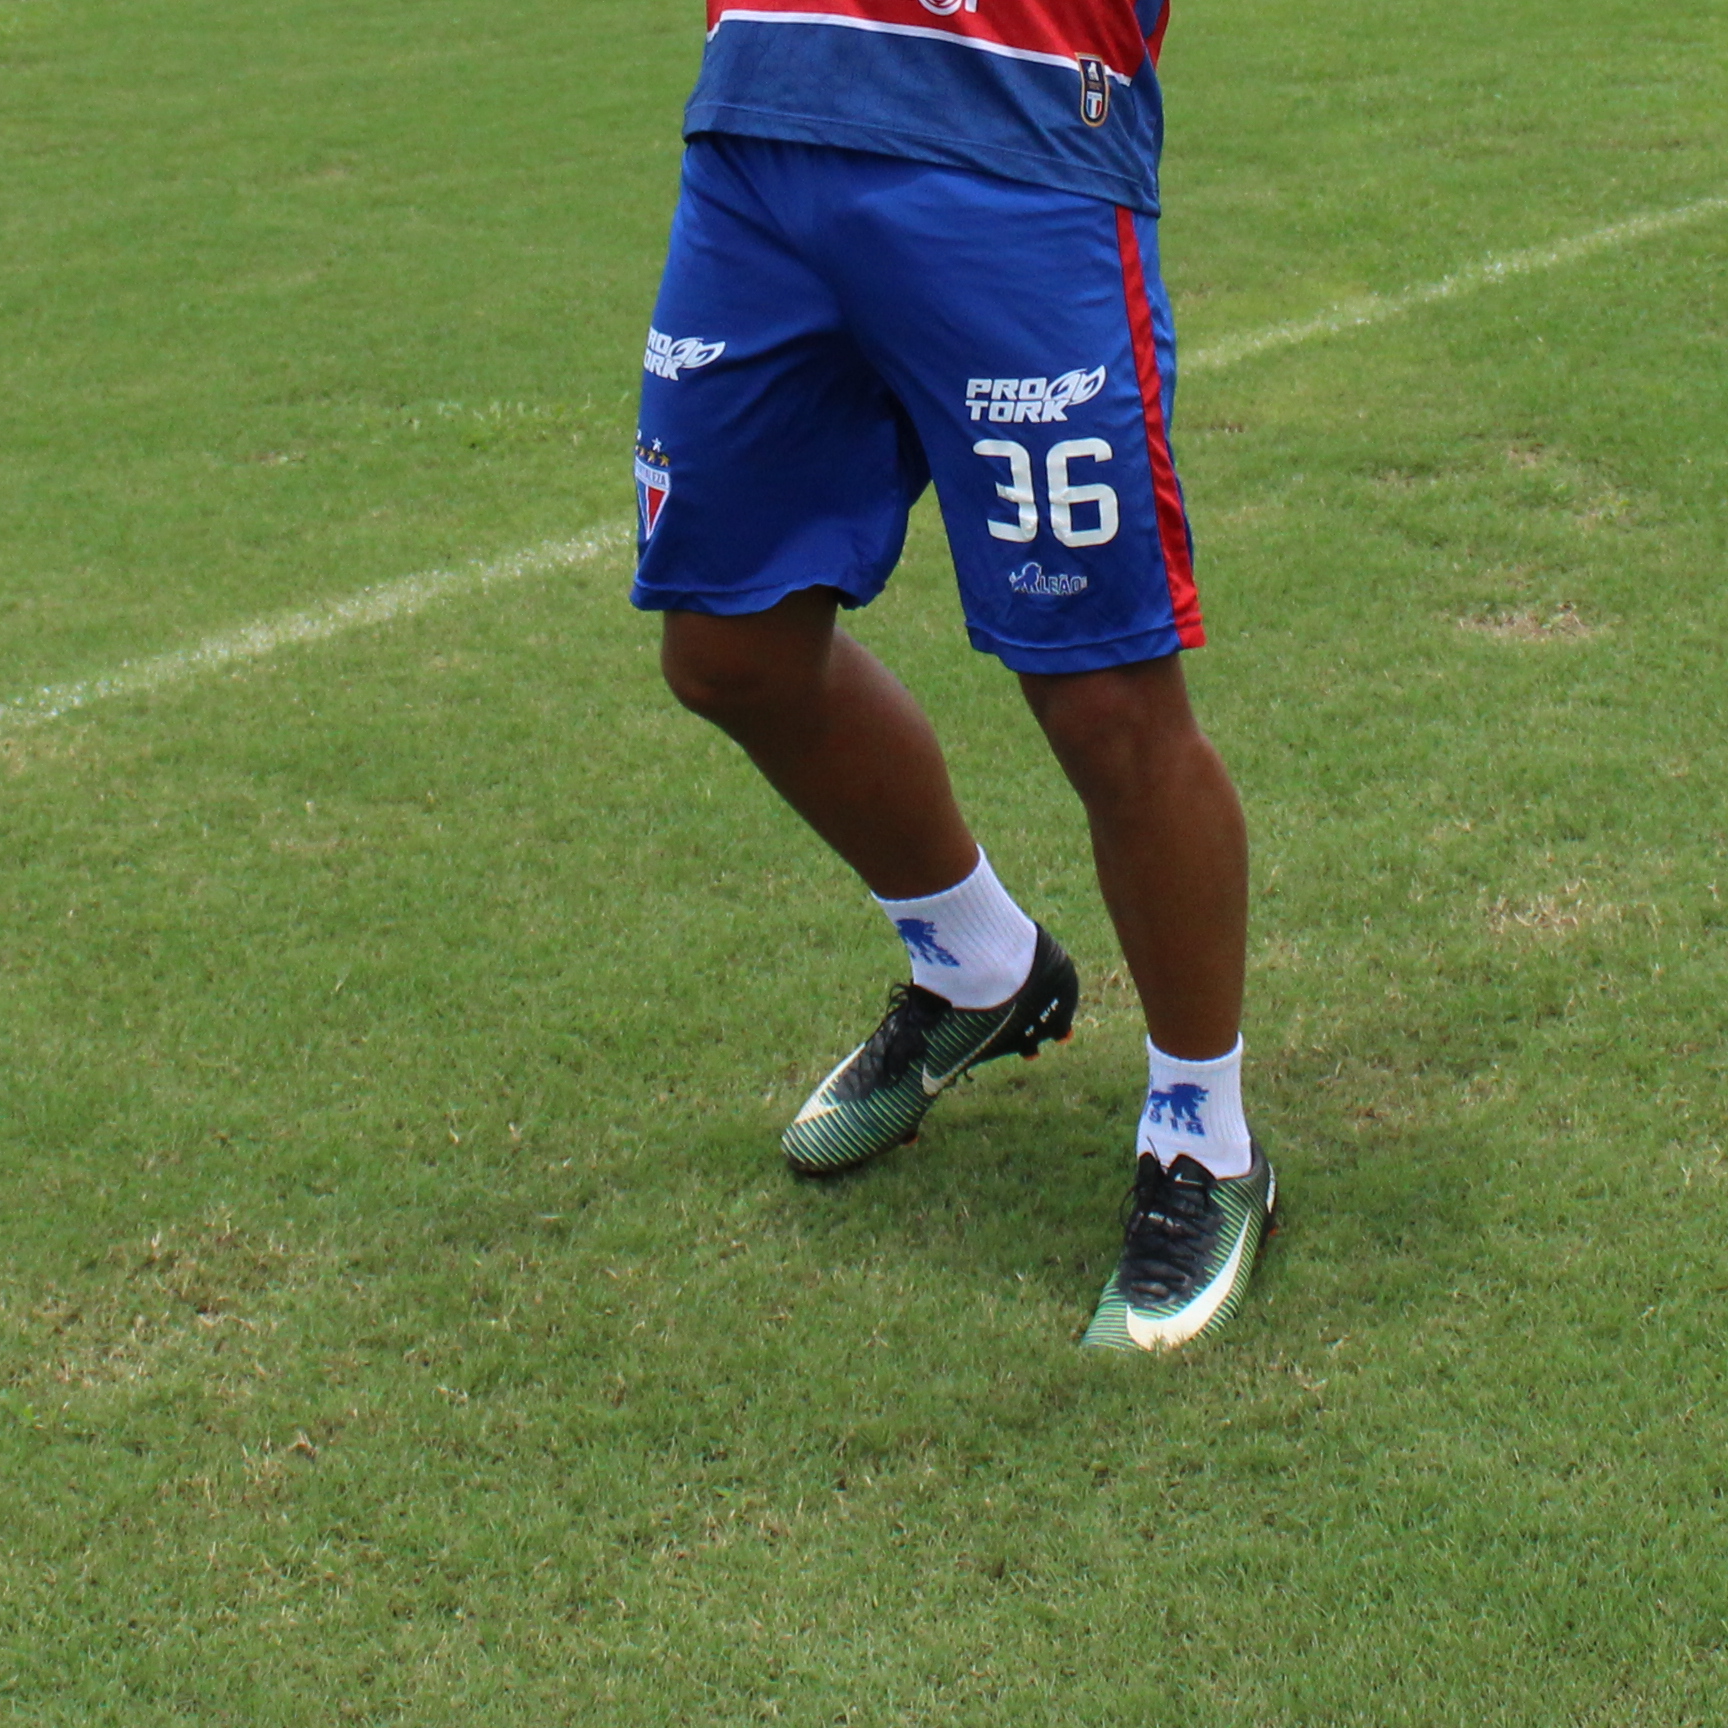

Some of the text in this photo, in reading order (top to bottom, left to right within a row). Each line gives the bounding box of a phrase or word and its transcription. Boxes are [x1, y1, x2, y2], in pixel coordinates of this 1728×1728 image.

[966, 377, 1048, 401] PRO
[965, 398, 1069, 423] TORK
[973, 437, 1120, 548] 36
